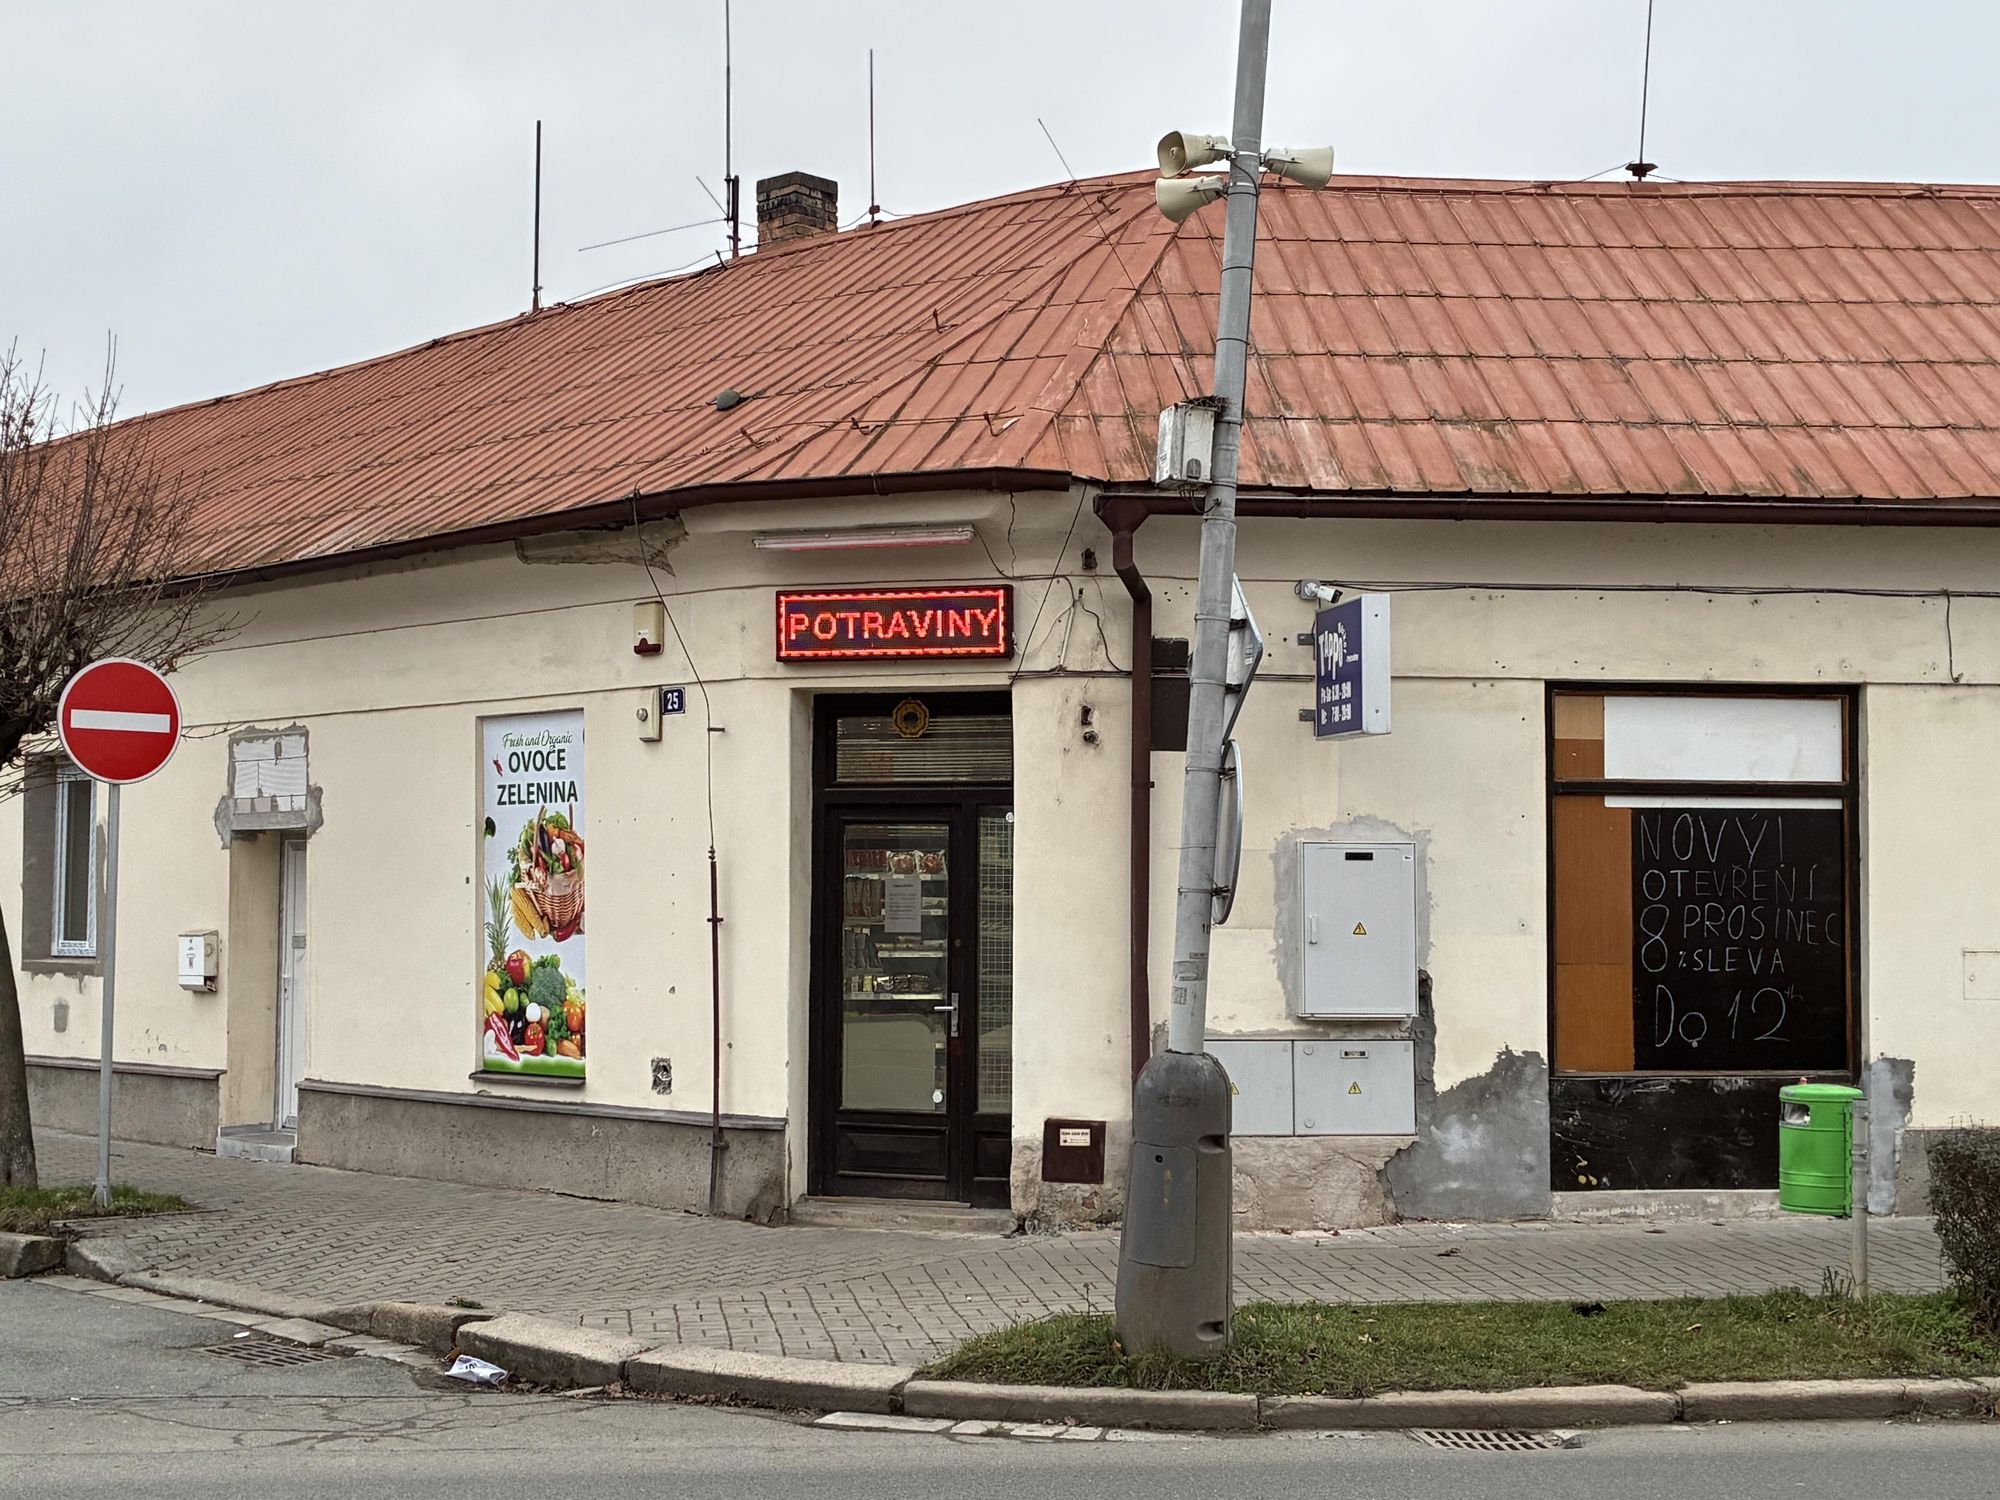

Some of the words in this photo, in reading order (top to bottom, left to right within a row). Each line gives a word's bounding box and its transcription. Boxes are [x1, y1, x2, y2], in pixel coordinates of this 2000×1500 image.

[789, 608, 998, 641] POTRAVINY
[667, 692, 679, 710] 25
[502, 732, 524, 749] Fresh
[525, 732, 541, 747] and
[541, 729, 574, 750] Organic
[508, 748, 567, 773] OVOCE
[496, 780, 579, 806] ZELENINA
[1683, 902, 1842, 946] PROSINEC
